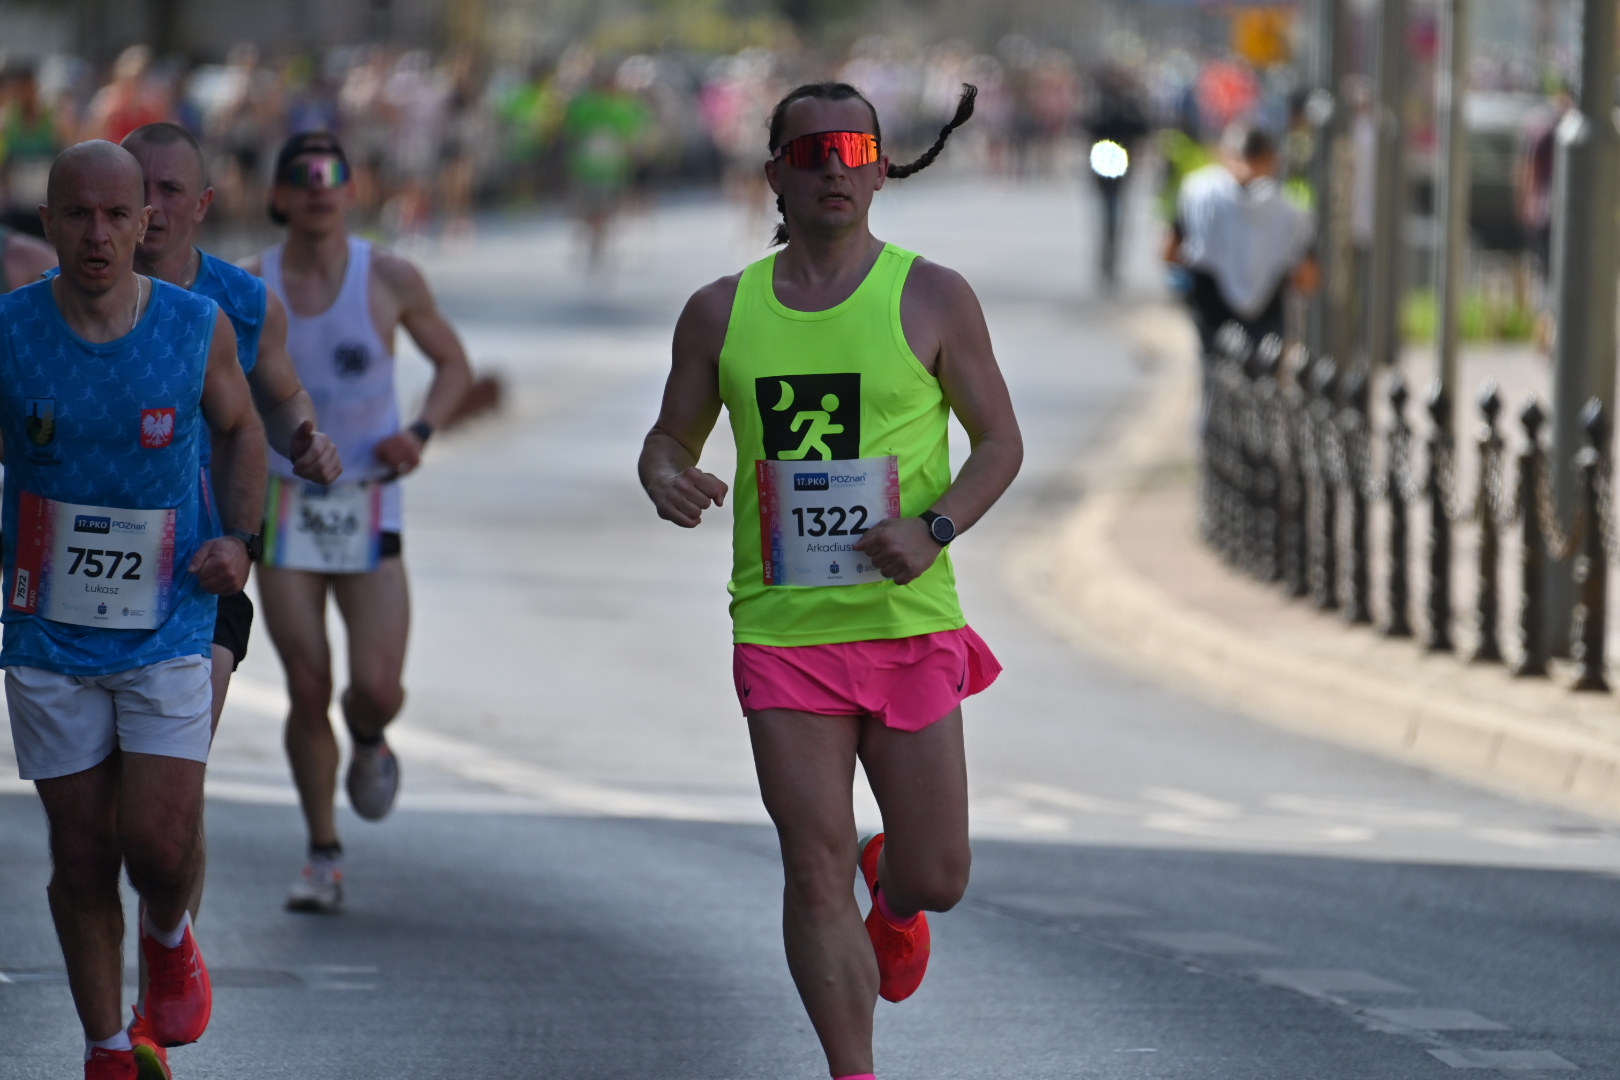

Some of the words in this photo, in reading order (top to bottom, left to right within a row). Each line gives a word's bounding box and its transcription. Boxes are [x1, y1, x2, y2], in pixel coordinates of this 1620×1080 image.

[796, 477, 826, 486] 17.PKO
[77, 519, 108, 529] 17.PKO
[791, 504, 870, 537] 1322
[67, 546, 142, 580] 7572
[764, 560, 772, 579] M30
[17, 574, 27, 599] 7572
[84, 583, 119, 595] Łukasz
